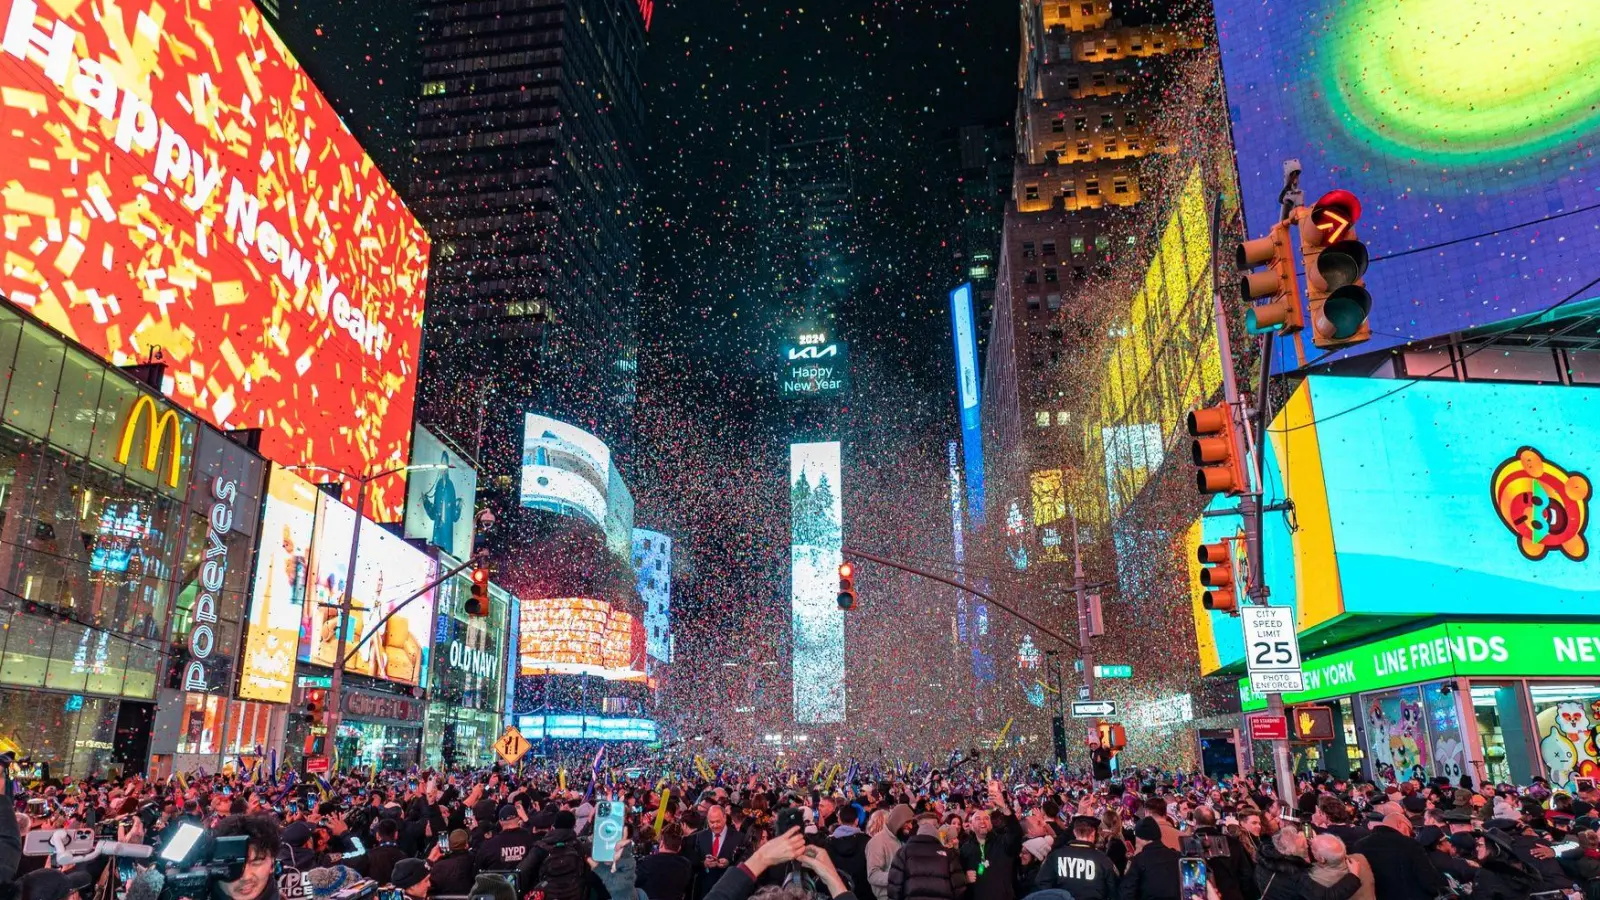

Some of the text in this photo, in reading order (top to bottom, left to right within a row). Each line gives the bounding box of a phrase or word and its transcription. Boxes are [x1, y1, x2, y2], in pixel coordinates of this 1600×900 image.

[1, 0, 219, 211] Happy
[225, 175, 312, 290] New
[799, 333, 825, 345] 2024
[792, 367, 833, 379] Happy
[785, 379, 841, 391] New Year
[1253, 620, 1282, 628] SPEED
[1257, 630, 1280, 638] LIMIT
[1253, 641, 1292, 664] 25
[1374, 636, 1509, 677] LINE FRIENDS
[450, 640, 498, 680] OLD NAVY
[1302, 660, 1356, 691] EW YORK
[1256, 681, 1299, 689] ENFORCED
[501, 845, 526, 857] NYPD
[1057, 856, 1096, 880] NYPD
